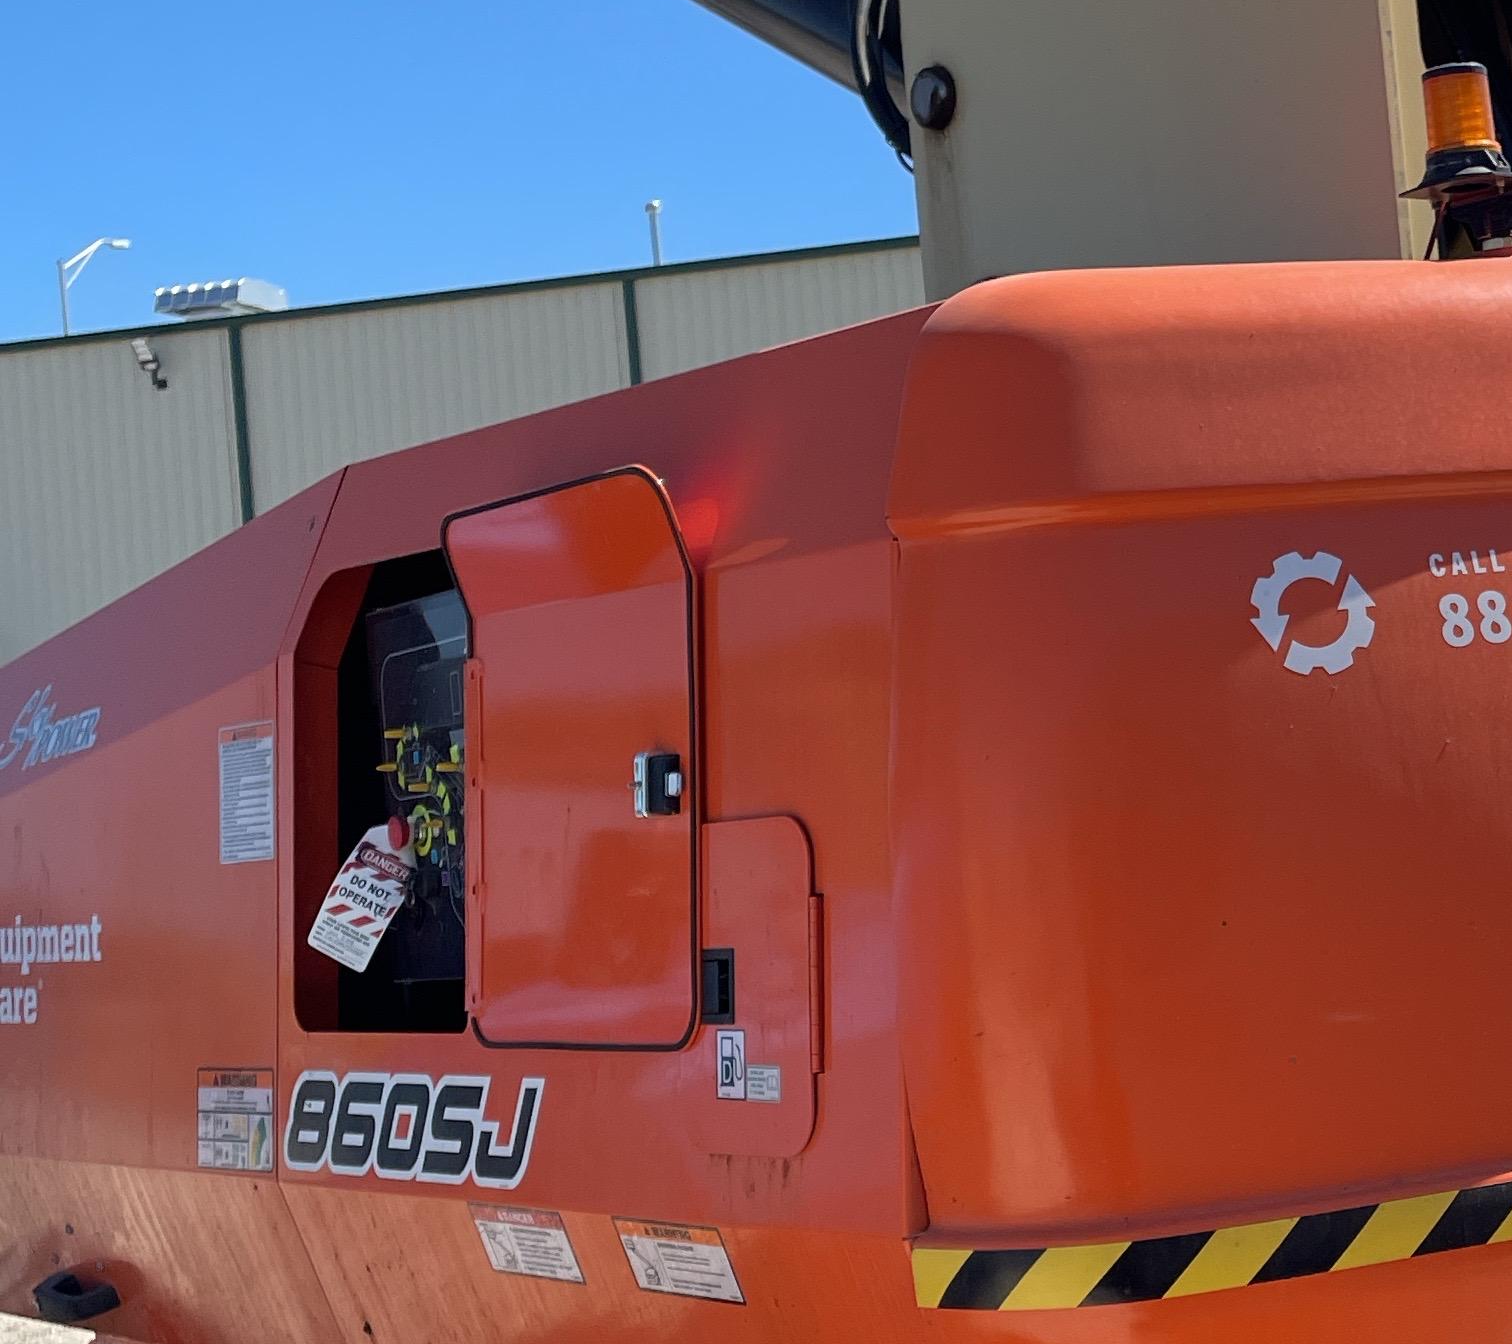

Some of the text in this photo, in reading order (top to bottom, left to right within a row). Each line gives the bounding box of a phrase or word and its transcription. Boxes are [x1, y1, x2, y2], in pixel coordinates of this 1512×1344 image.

[1429, 548, 1506, 578] CALL
[362, 850, 409, 880] DANGER
[338, 886, 388, 918] OPERATE
[350, 874, 392, 902] DO NOT
[284, 1069, 545, 1190] 860SJ
